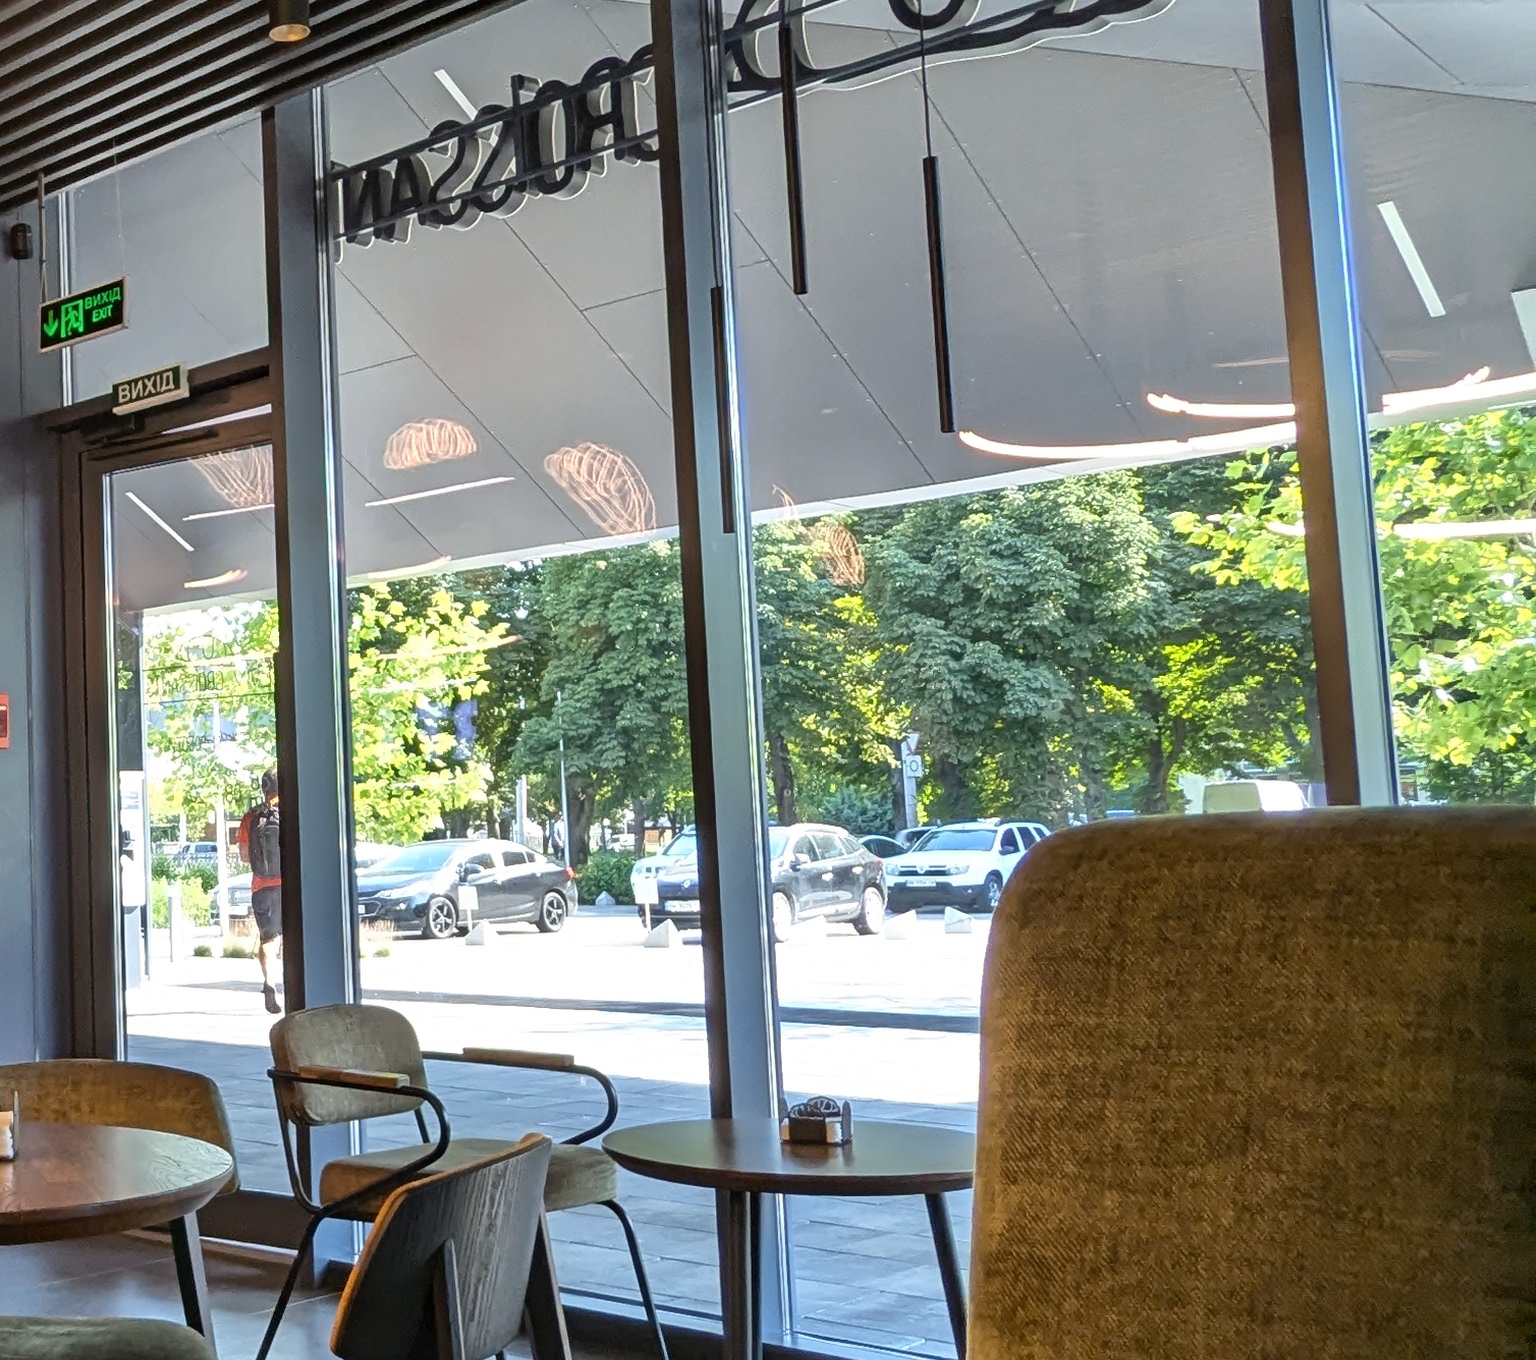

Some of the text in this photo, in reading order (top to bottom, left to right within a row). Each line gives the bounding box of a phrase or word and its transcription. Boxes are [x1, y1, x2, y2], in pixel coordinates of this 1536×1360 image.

[85, 287, 121, 309] ВИХІД
[92, 305, 113, 322] EXIT
[118, 371, 175, 403] ВИХІД
